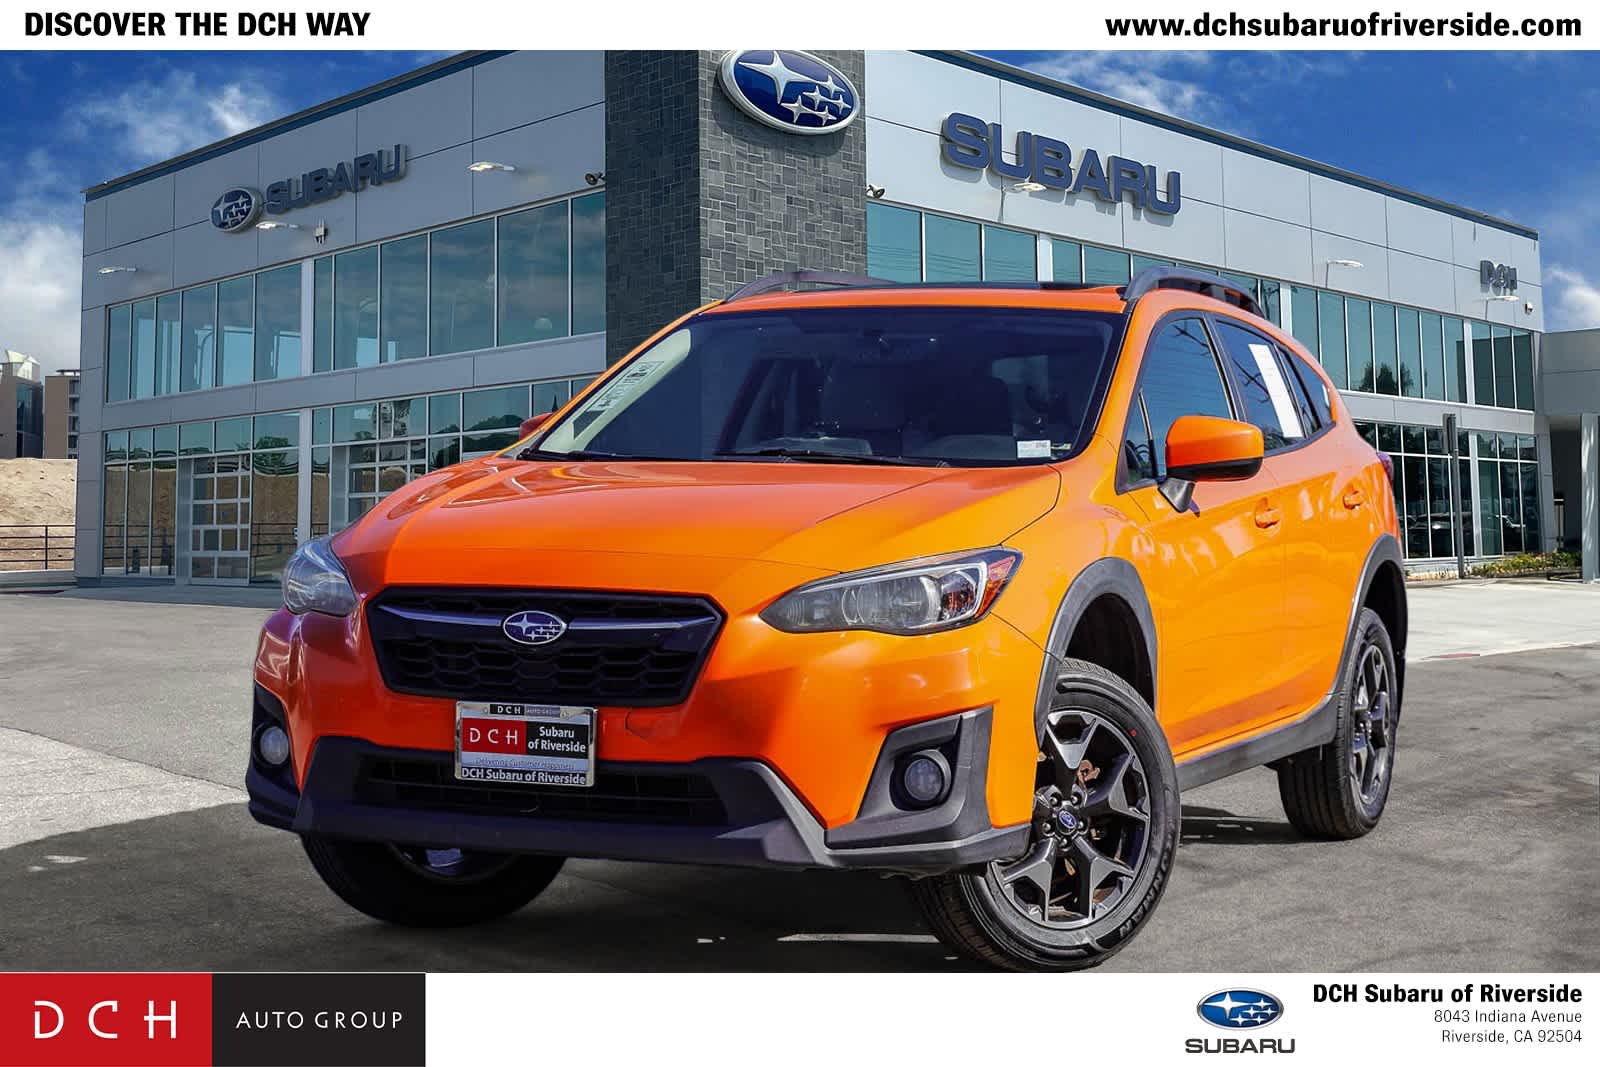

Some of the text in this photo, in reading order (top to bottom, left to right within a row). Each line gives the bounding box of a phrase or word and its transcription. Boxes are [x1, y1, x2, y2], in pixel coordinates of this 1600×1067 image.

[939, 112, 1181, 215] SUBARU
[265, 143, 407, 215] SUBARU
[496, 705, 521, 714] DCH
[469, 727, 518, 745] DCH
[539, 726, 575, 738] Subaru
[528, 739, 586, 753] of Riverside
[462, 767, 586, 785] DCH Subaru of Riverside
